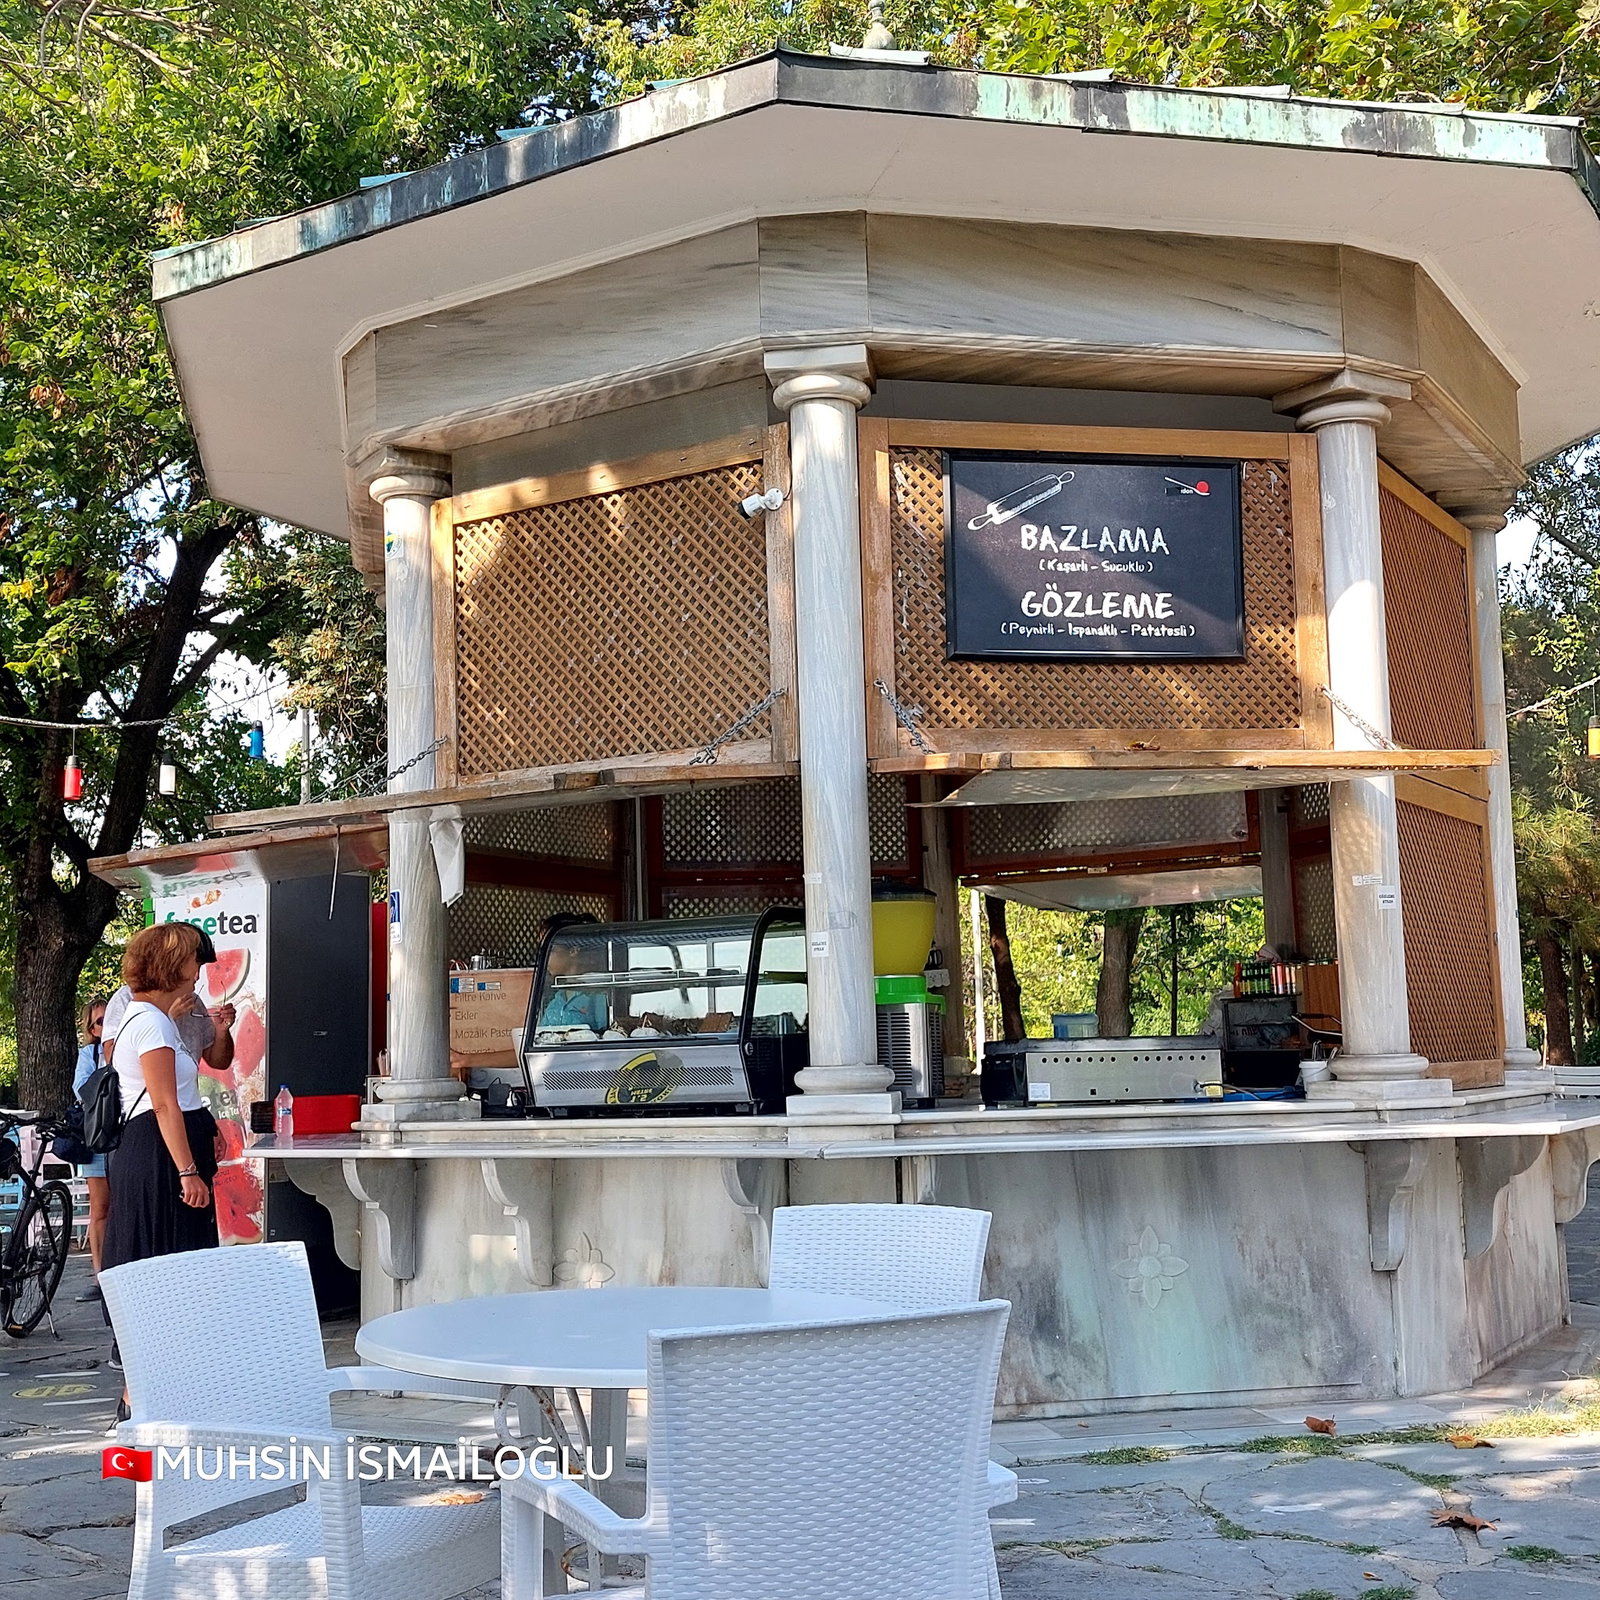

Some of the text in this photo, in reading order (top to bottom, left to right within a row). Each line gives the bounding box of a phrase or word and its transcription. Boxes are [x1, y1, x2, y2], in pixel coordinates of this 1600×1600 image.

[1020, 524, 1170, 555] BAZLAMA
[1020, 583, 1175, 619] GÖZLEME
[164, 911, 258, 935] fetea
[455, 1011, 479, 1021] Ekler
[455, 1028, 488, 1039] Mozaik
